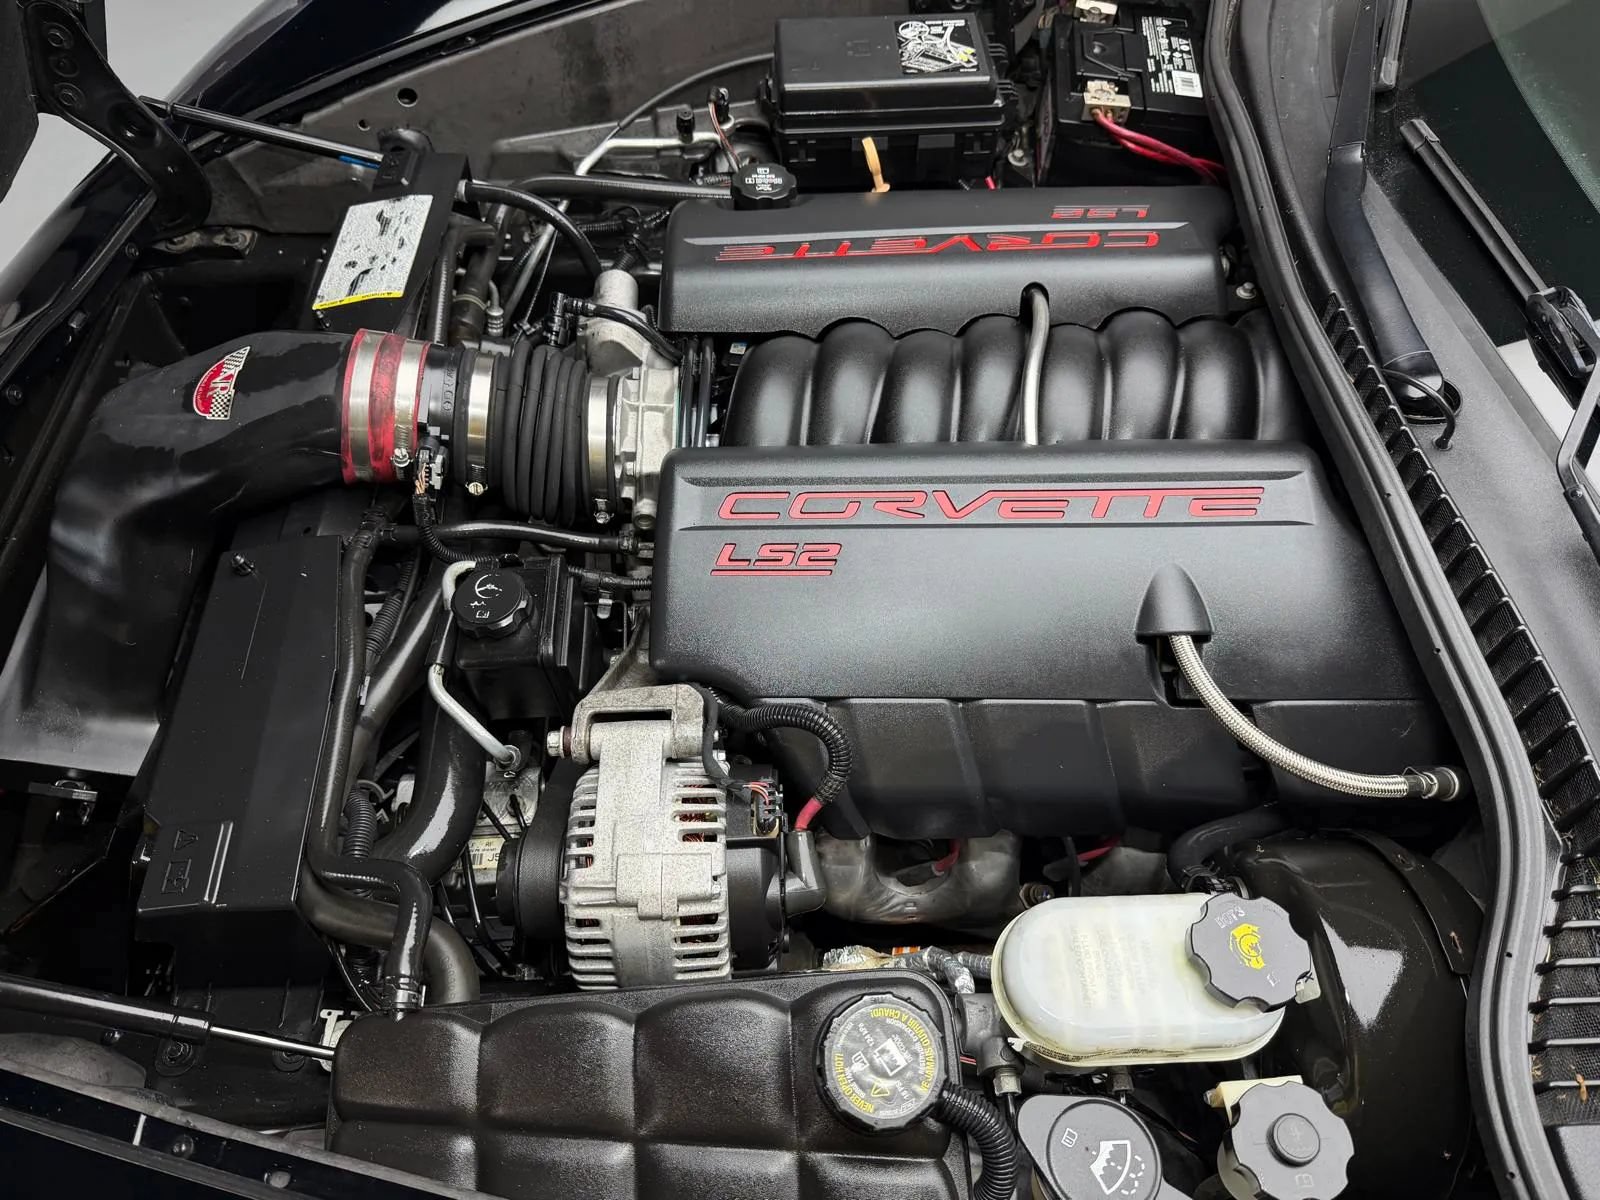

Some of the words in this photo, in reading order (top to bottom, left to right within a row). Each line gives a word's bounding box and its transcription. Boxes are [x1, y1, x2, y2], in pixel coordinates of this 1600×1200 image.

[1051, 206, 1150, 220] LS2
[716, 231, 1161, 261] CORVETTE
[719, 487, 1263, 519] CORVETTE
[715, 543, 842, 567] LS2
[871, 1008, 901, 1018] CHAUD!
[907, 1016, 929, 1047] OUVRIR
[834, 1054, 844, 1074] HOT!
[925, 1047, 936, 1083] JAMAIS
[837, 1074, 854, 1097] OPEN
[850, 1093, 875, 1113] NEVER
